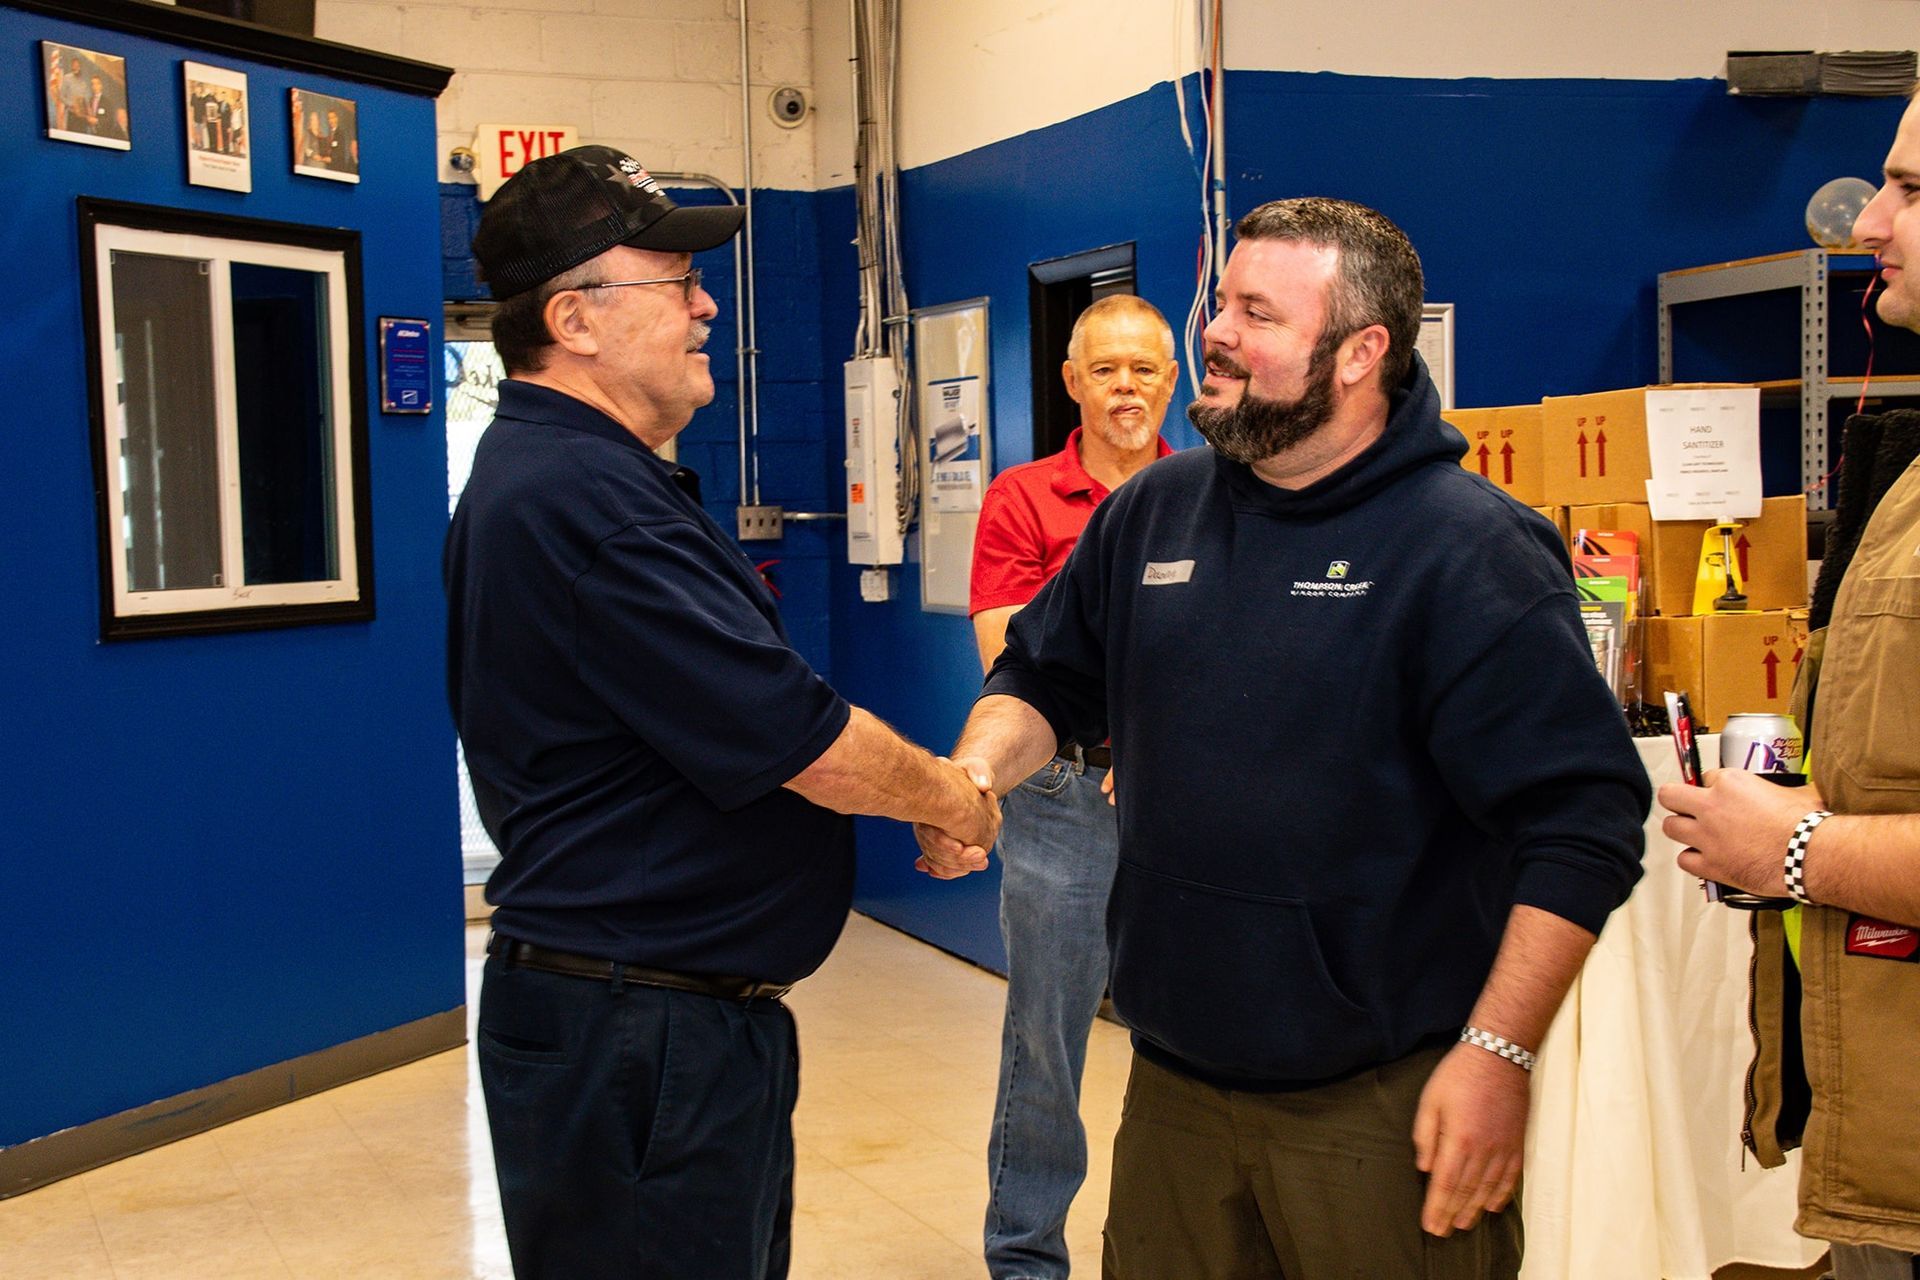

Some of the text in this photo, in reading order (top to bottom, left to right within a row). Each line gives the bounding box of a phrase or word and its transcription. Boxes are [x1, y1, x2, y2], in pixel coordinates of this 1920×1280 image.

[499, 130, 565, 178] EXIT
[1577, 416, 1588, 428] UP
[1595, 415, 1607, 426] UP
[1477, 430, 1490, 440] UP
[1500, 429, 1514, 439] UP
[1689, 425, 1713, 434] HAND
[1293, 581, 1344, 591] THOMPSON
[1763, 635, 1779, 646] UP
[1855, 924, 1910, 942] Milwaukee
